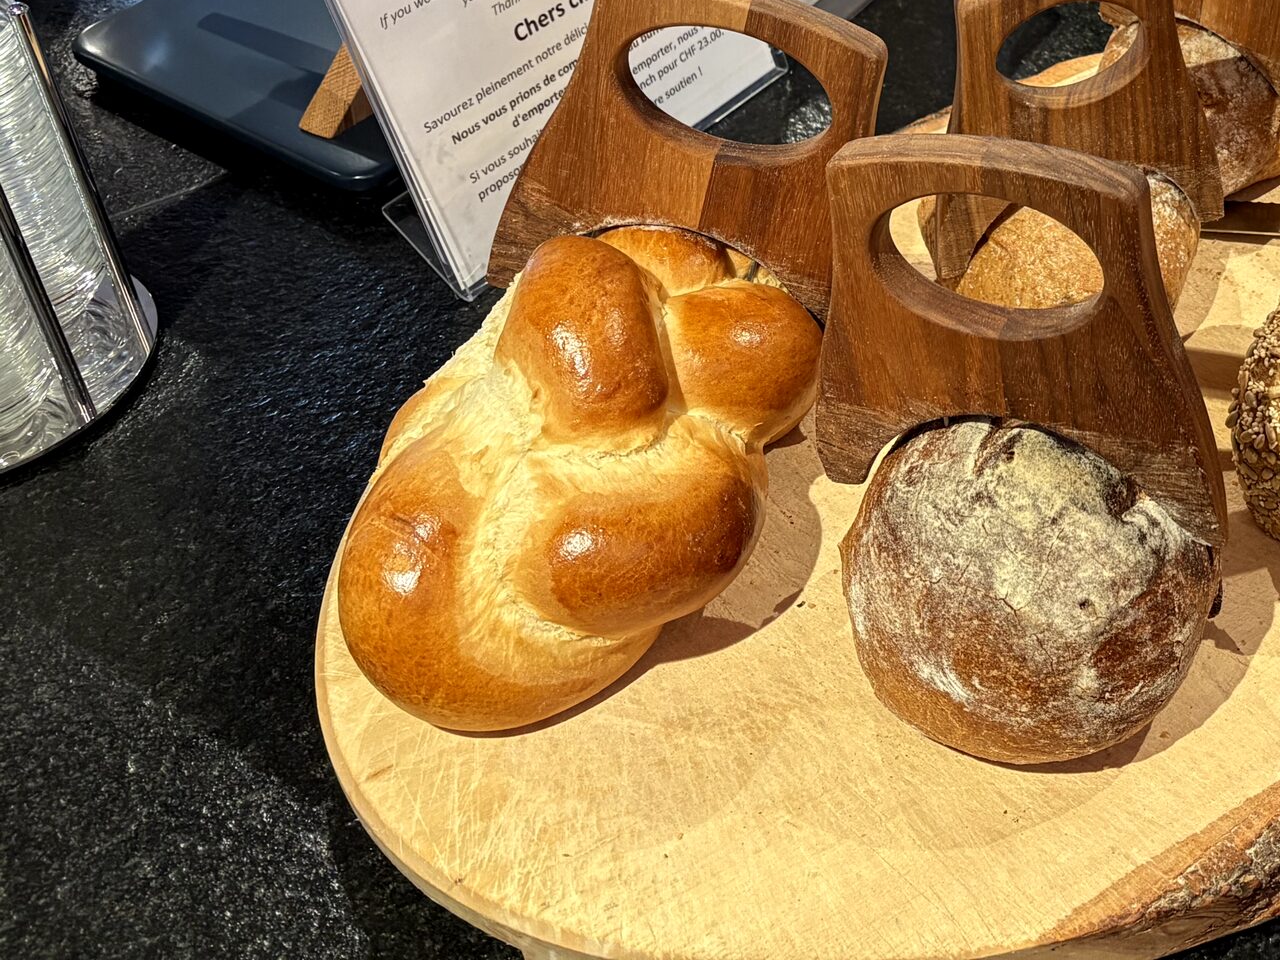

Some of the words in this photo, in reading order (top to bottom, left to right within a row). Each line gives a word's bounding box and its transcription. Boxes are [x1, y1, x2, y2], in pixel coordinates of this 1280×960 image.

[379, 12, 389, 31] If
[390, 4, 412, 25] you
[513, 2, 565, 41] Chers
[657, 58, 678, 80] pour
[678, 44, 696, 63] CHF
[697, 27, 724, 51] 23.00.
[423, 97, 475, 134] Savourez
[475, 59, 535, 105] pleinement
[534, 42, 563, 65] notre
[451, 121, 481, 145] Nous
[481, 104, 508, 126] vous
[508, 82, 542, 112] prions
[542, 73, 557, 87] de
[469, 169, 480, 184] Si
[480, 154, 507, 175] vous
[632, 42, 677, 75] emporter,
[676, 25, 698, 45] nous
[664, 72, 697, 99] soutien
